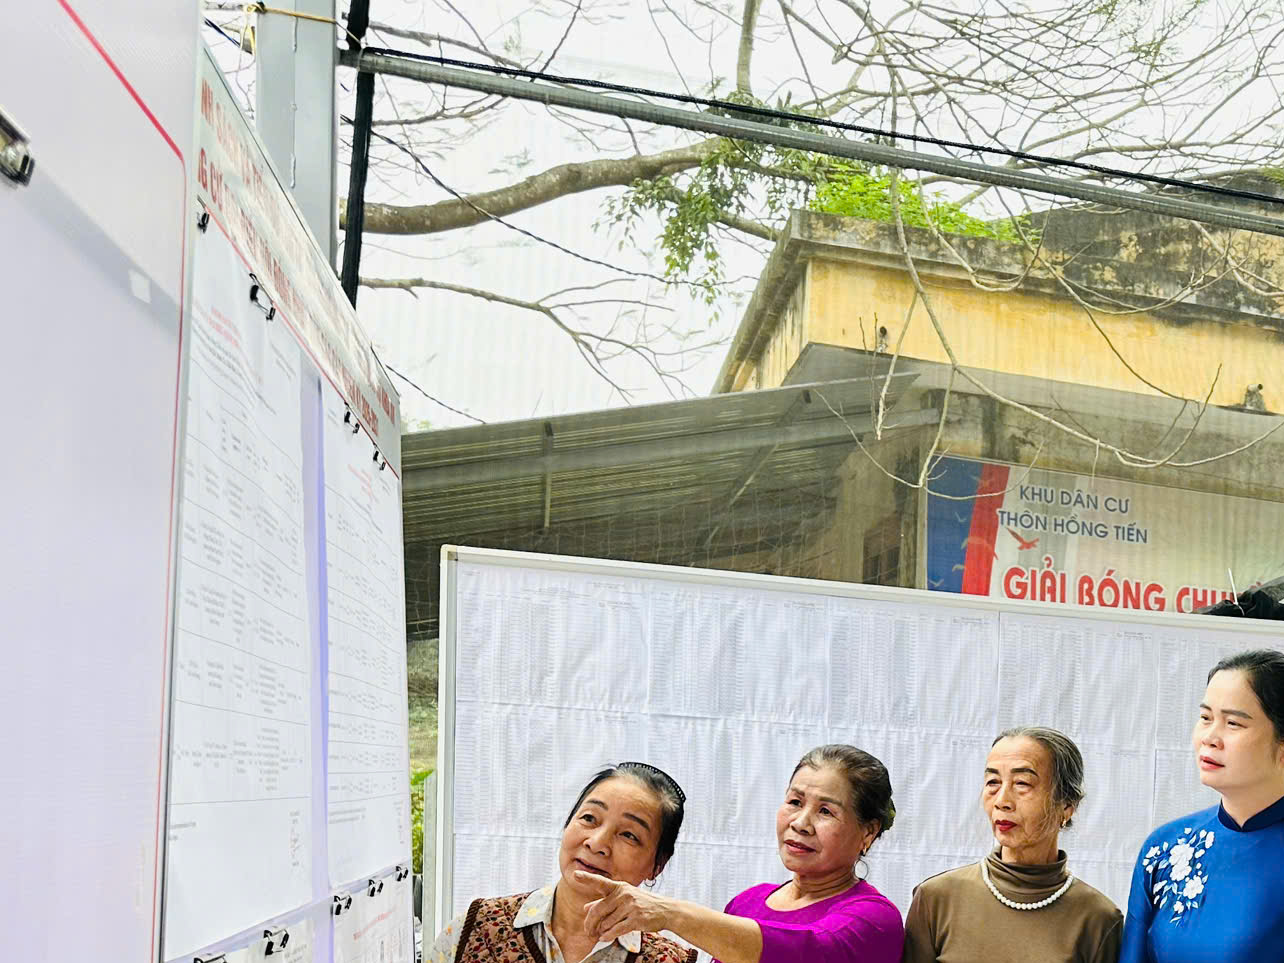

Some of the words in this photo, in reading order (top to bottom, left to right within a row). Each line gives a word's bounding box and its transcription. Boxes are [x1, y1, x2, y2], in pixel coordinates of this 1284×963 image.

[1019, 485, 1054, 504] KHU
[1060, 489, 1098, 510] DÂN
[1104, 497, 1129, 514] CƯ
[998, 510, 1047, 531] THÔN
[1053, 514, 1108, 538] HỒNG
[1114, 523, 1148, 544] TIẾN
[1004, 556, 1067, 604] GIẢI
[1077, 569, 1166, 612] BÓNG
